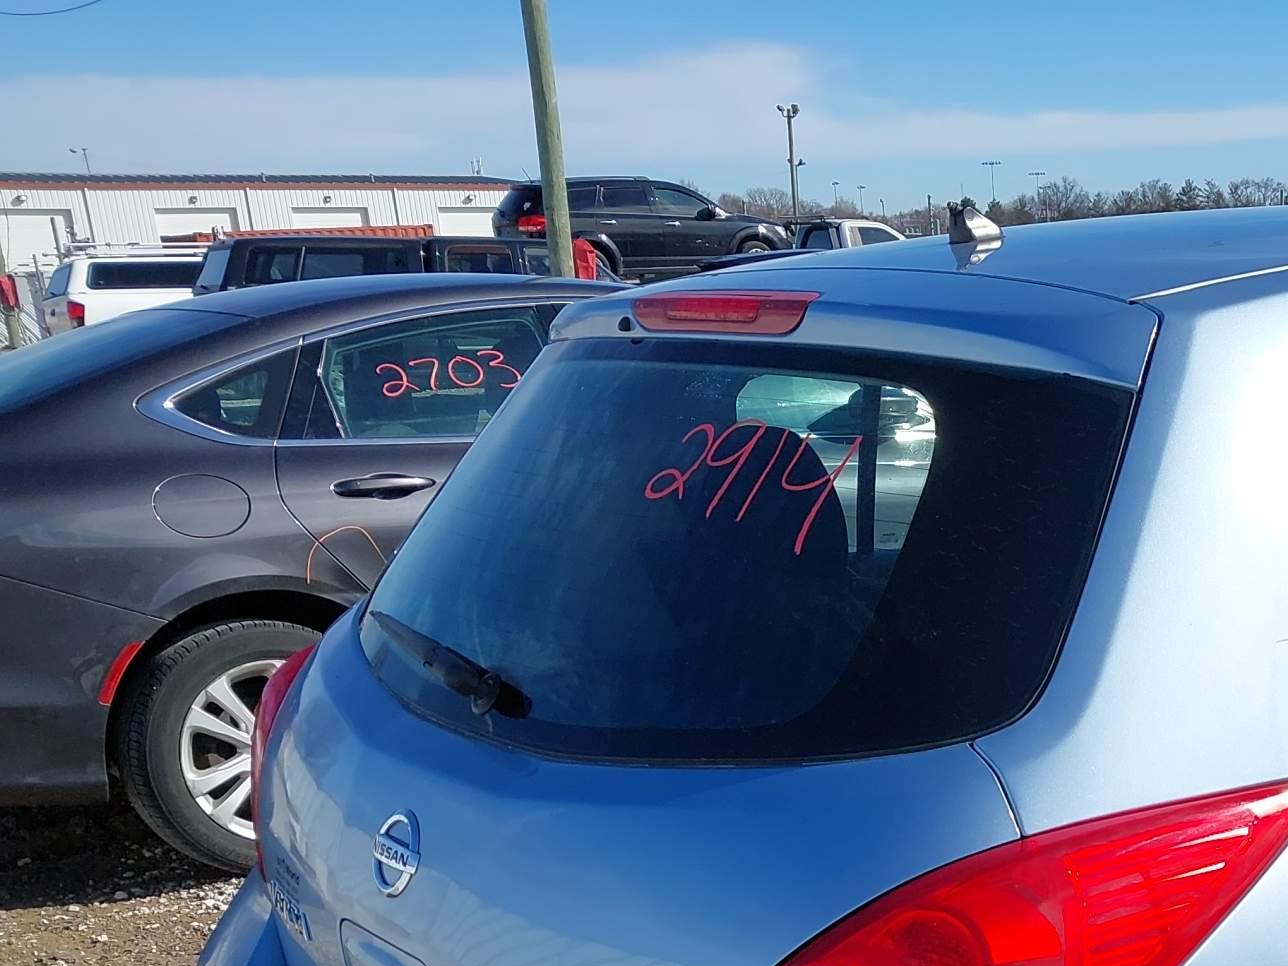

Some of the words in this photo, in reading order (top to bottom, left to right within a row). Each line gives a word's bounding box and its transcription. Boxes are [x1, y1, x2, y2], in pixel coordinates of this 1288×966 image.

[376, 349, 522, 397] 2703
[644, 417, 863, 556] 2914
[374, 839, 410, 867] NISSAN
